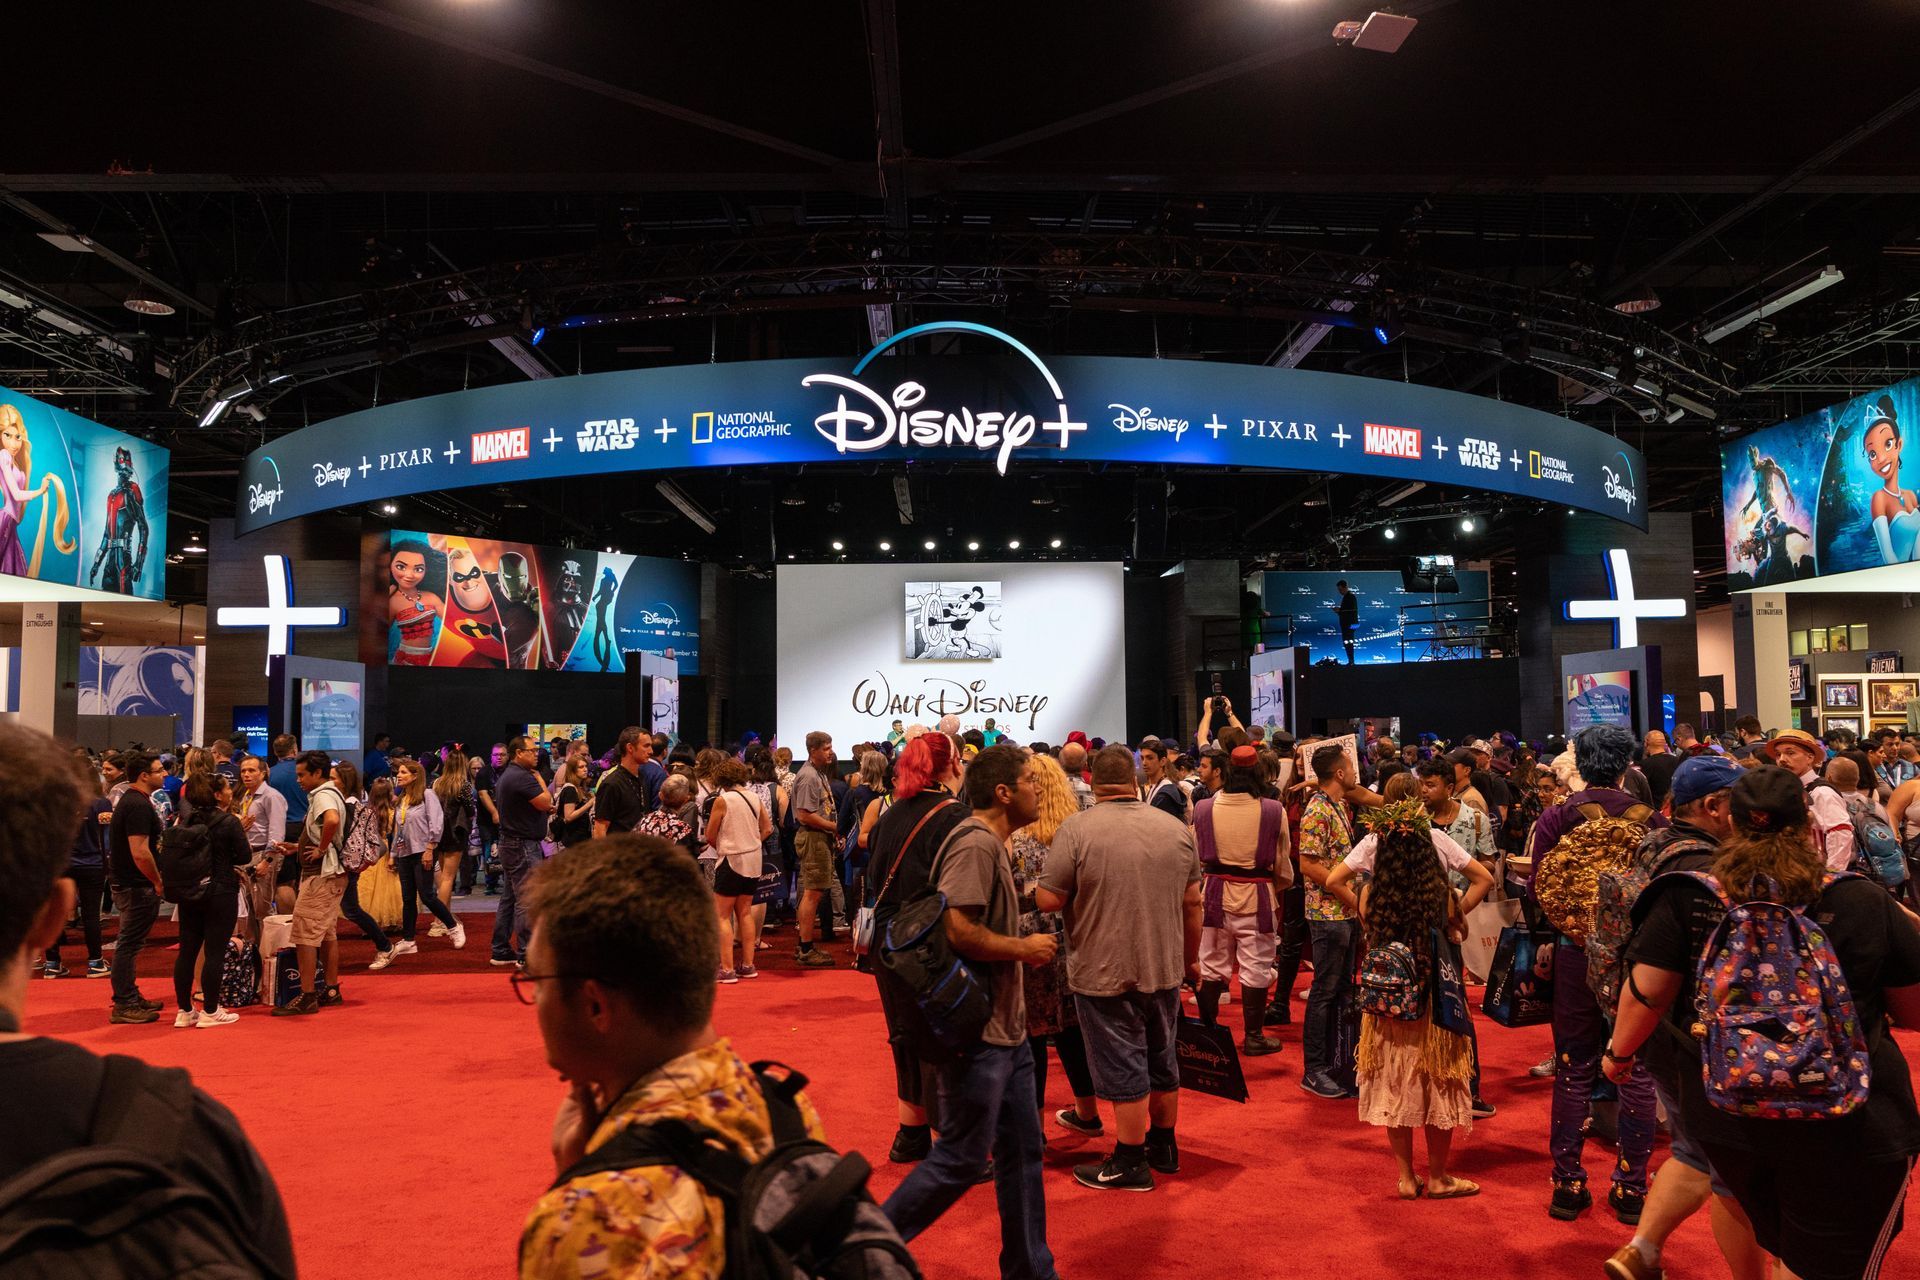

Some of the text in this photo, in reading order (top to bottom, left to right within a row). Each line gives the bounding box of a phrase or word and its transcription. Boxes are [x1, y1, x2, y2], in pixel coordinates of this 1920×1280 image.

[576, 418, 640, 437] STAR
[717, 410, 777, 426] NATIONAL
[716, 423, 792, 440] GEOGRAPHIC
[1242, 419, 1318, 442] PIXAR
[1365, 425, 1420, 458] MARVEL
[379, 447, 434, 471] PIXAR
[471, 428, 530, 463] MARVEL
[576, 433, 640, 453] WARS
[1458, 437, 1501, 458] STAR
[1458, 450, 1501, 471] WARS
[1541, 455, 1568, 471] NATIONAL
[1541, 467, 1575, 484] GEOGRAPHIC
[1871, 659, 1895, 673] BUENA
